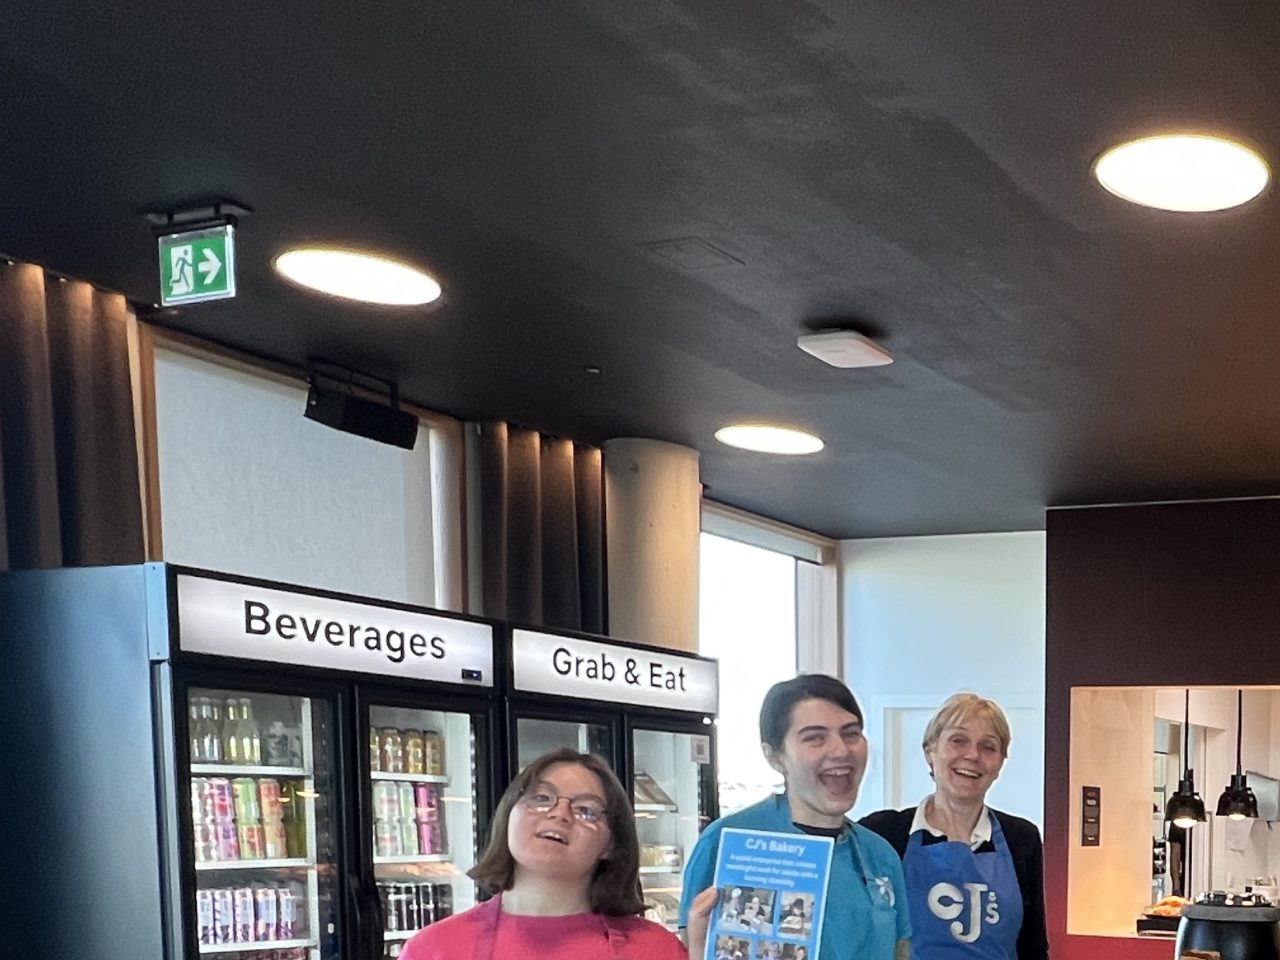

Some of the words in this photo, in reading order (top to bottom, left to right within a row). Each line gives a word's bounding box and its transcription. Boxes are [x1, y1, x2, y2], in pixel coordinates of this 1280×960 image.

[243, 599, 447, 664] Beverages
[552, 647, 616, 683] Grab
[624, 659, 641, 685] &
[649, 662, 687, 693] Eat
[769, 840, 806, 857] Bakery
